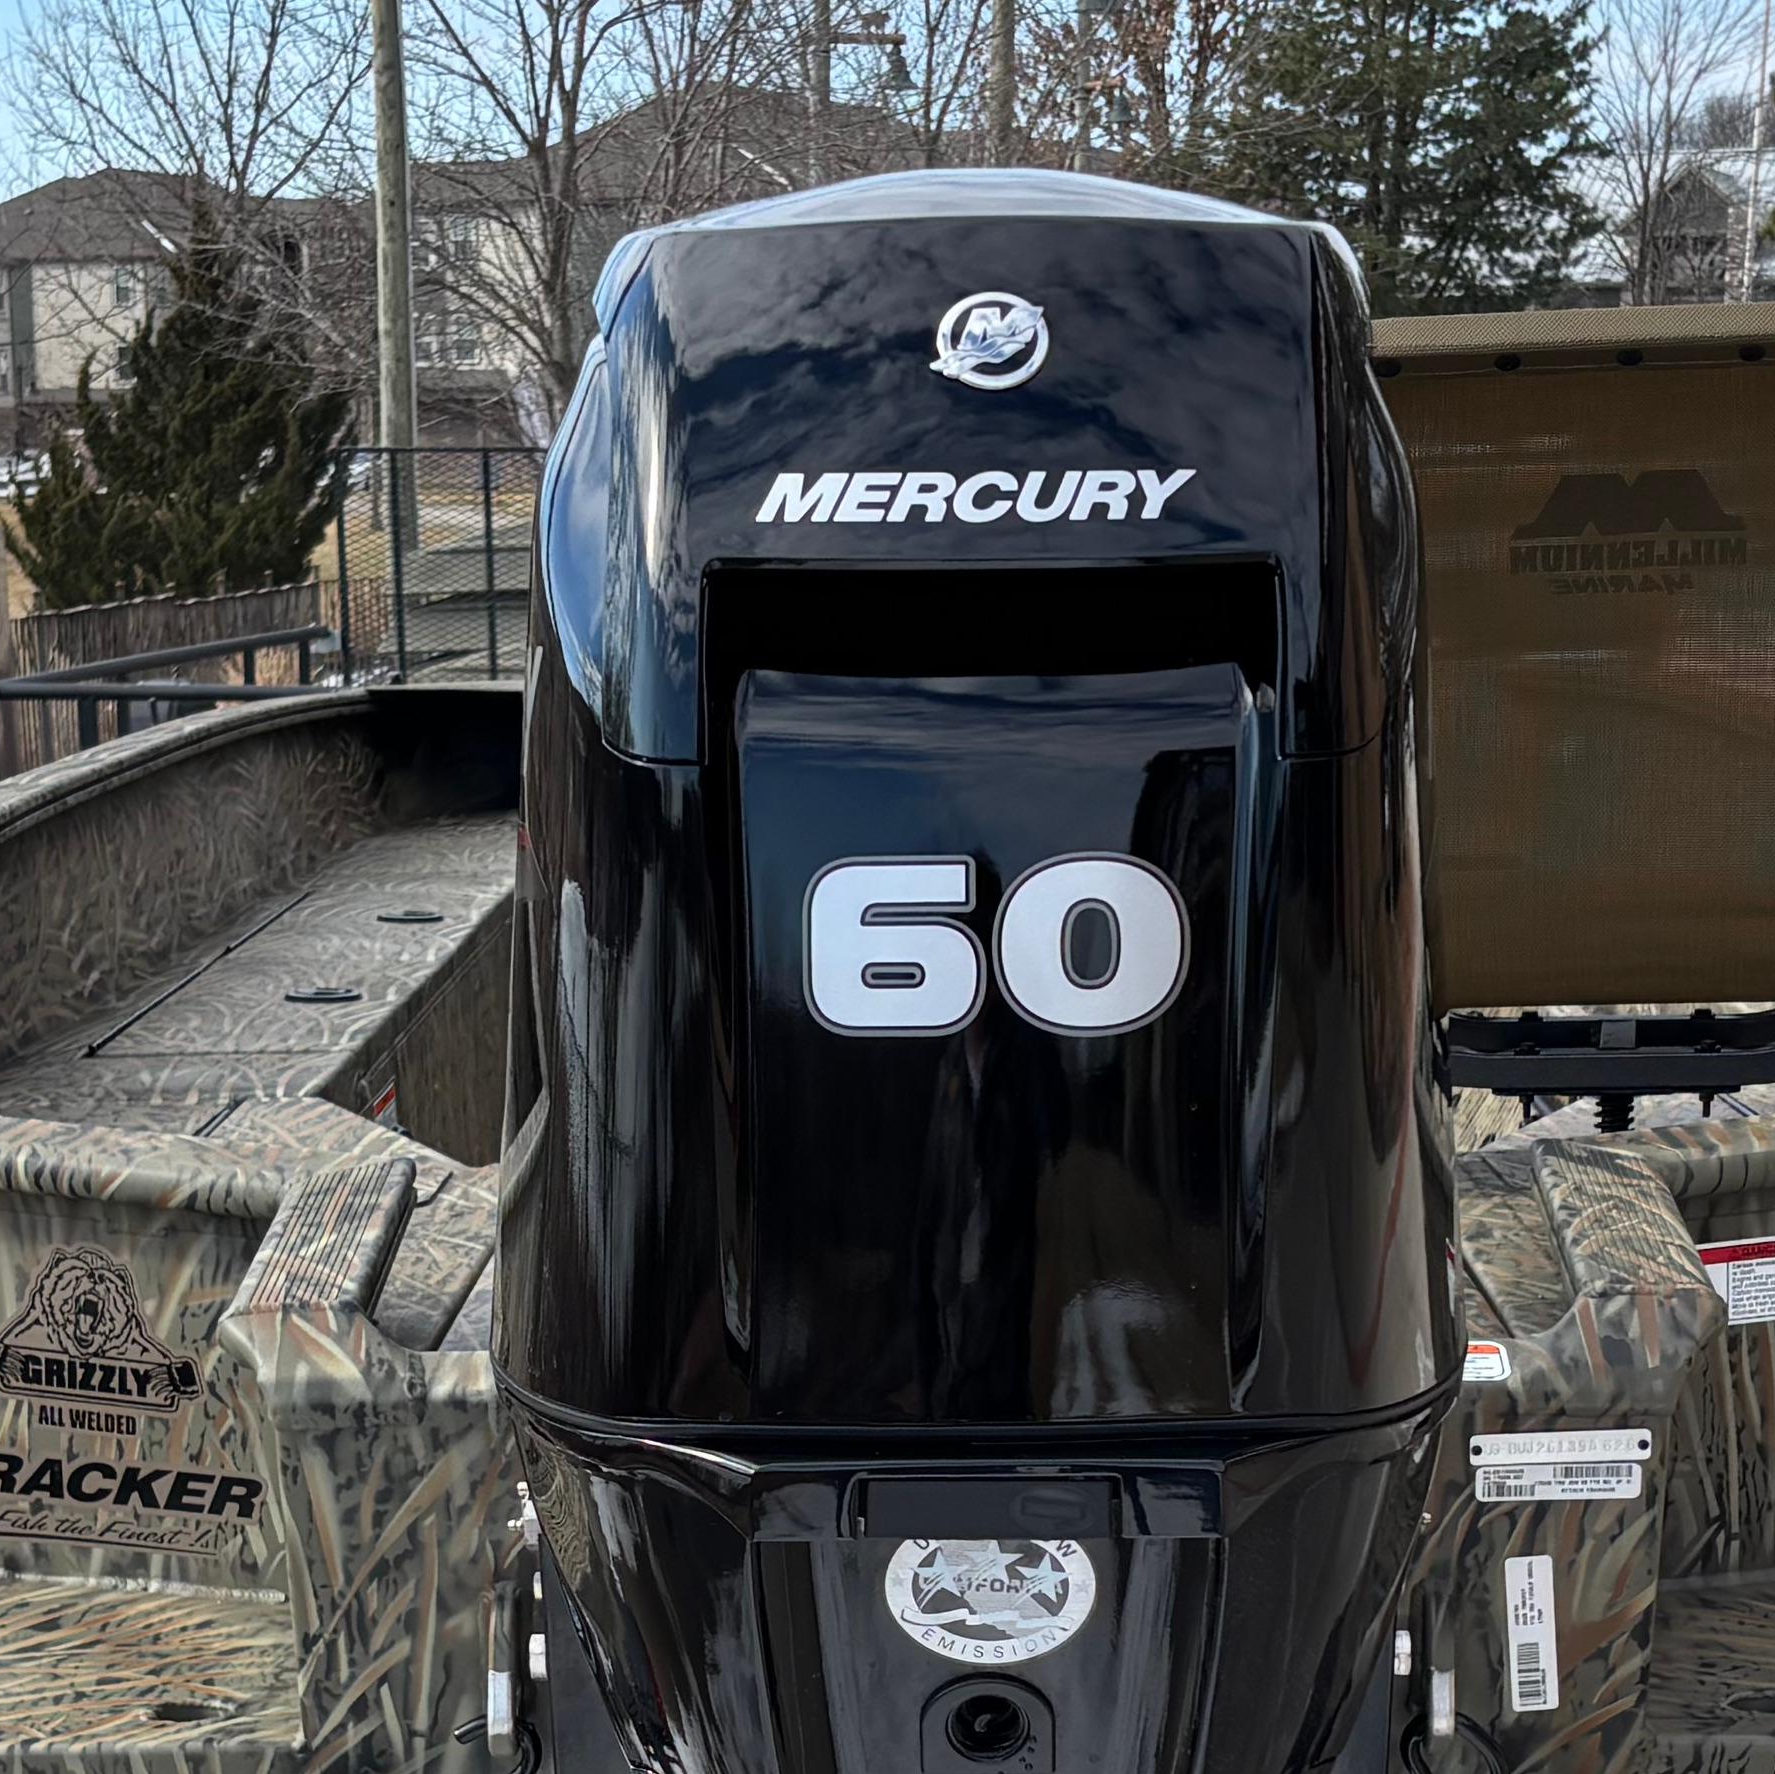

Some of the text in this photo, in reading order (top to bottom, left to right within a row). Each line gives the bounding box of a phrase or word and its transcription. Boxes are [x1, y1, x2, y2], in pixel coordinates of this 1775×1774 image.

[754, 468, 1197, 524] MERCURY
[802, 850, 1192, 1038] 60
[21, 1355, 150, 1398] GRIZZLY
[38, 1405, 138, 1436] ALL WELDED
[53, 1516, 97, 1537] the
[920, 1627, 1058, 1659] EMISSION
